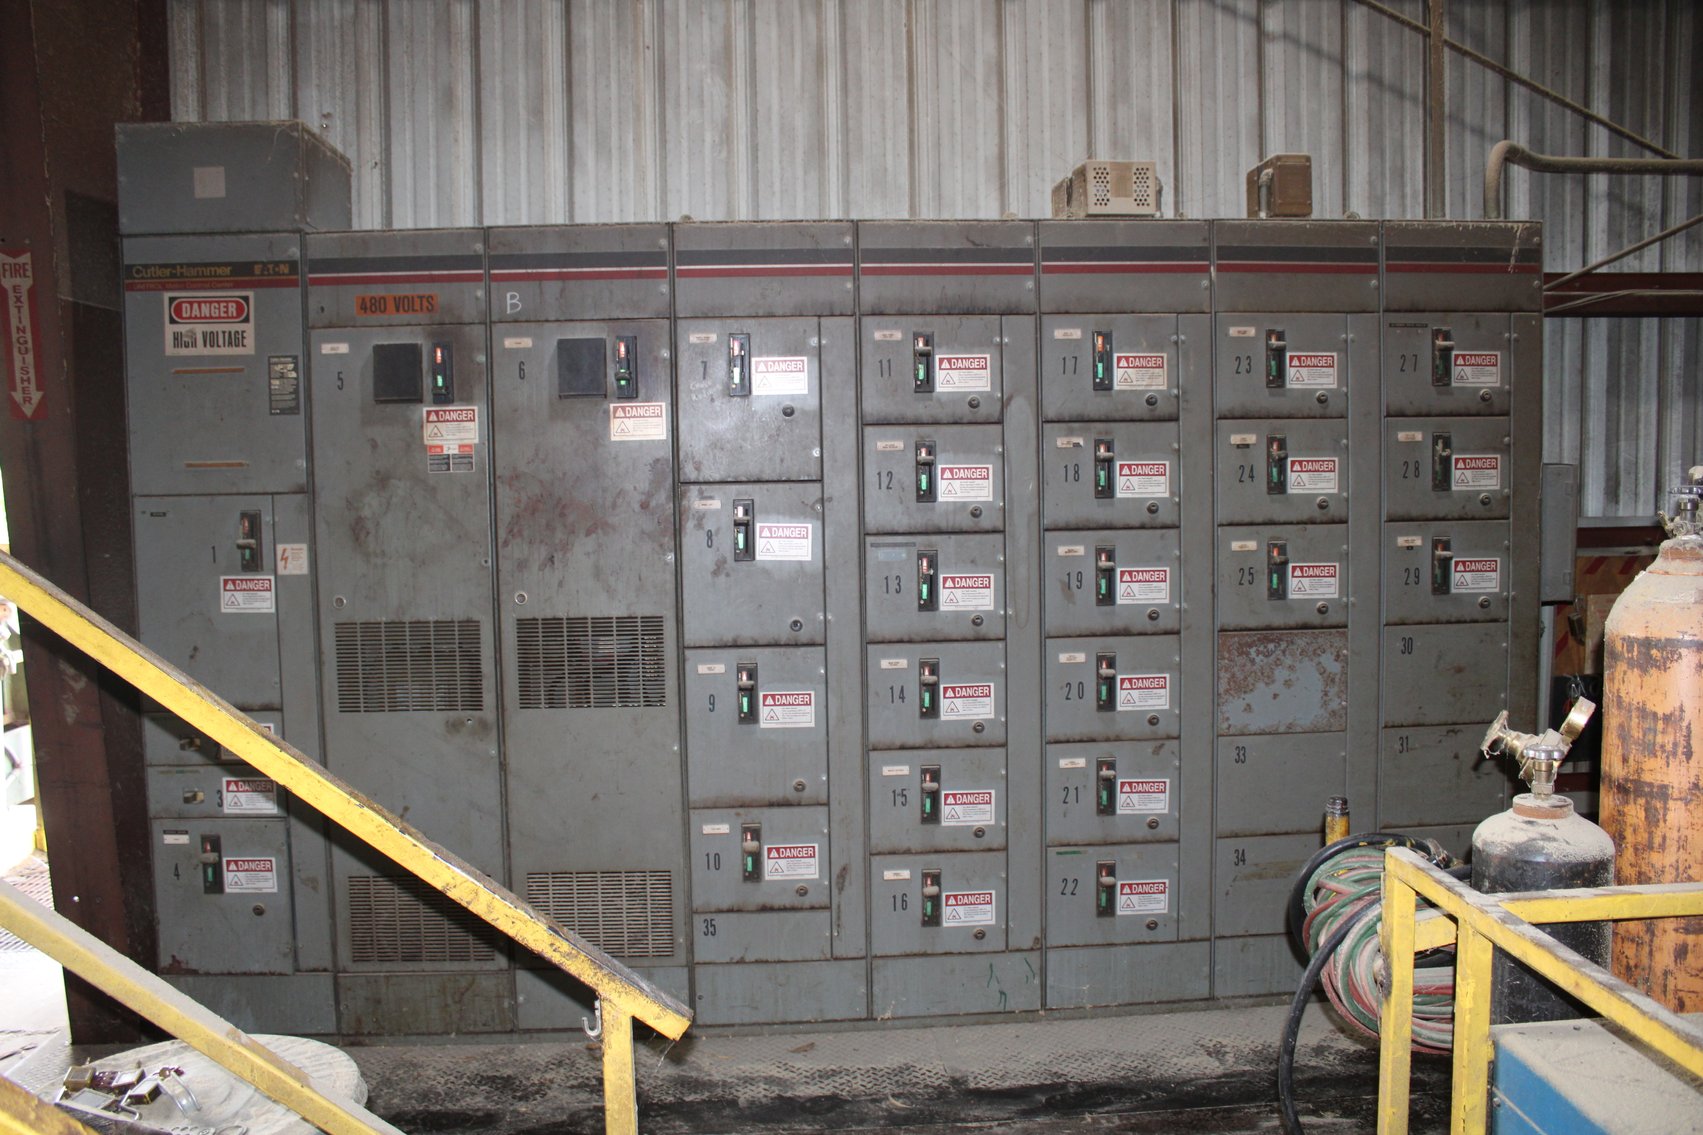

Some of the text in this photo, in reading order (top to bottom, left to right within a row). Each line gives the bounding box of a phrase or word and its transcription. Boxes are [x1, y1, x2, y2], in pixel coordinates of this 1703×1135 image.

[2, 262, 30, 279] FIRE
[132, 264, 232, 278] Cutler-Hammer
[182, 302, 237, 318] DANGER
[360, 294, 434, 313] 480 VOLTS
[506, 292, 522, 314] B
[12, 284, 33, 405] EXTINGUISHER
[202, 330, 246, 348] VOLTAGE
[767, 361, 803, 373] DANGER
[877, 358, 892, 378] 11
[951, 358, 986, 369] DANGER
[1061, 356, 1078, 375] 17
[1128, 356, 1163, 367] DANGER
[1235, 355, 1252, 375] 23
[1300, 355, 1333, 366] DANGER
[1400, 354, 1418, 372] 27
[1465, 355, 1496, 366] DANGER
[518, 361, 526, 380] 6
[700, 360, 707, 380] 7
[336, 371, 344, 391] 5
[439, 410, 474, 422] DANGER
[625, 406, 662, 418] DANGER
[1063, 464, 1080, 482] 18
[1131, 465, 1165, 476] DANGER
[1301, 460, 1334, 471] DANGER
[1402, 460, 1420, 479] 28
[1465, 459, 1497, 469] DANGER
[877, 470, 893, 490] 12
[953, 468, 988, 479] DANGER
[1238, 464, 1255, 483] 24
[706, 528, 713, 548] 8
[771, 526, 808, 538] DANGER
[211, 545, 216, 564] 1
[1302, 566, 1335, 577] DANGER
[1465, 561, 1496, 572] DANGER
[235, 580, 270, 590] DANGER
[884, 575, 902, 594] 13
[954, 577, 990, 588] DANGER
[1066, 571, 1083, 590] 19
[1131, 571, 1166, 582] DANGER
[1238, 567, 1255, 585] 25
[1404, 567, 1420, 586] 29
[1401, 637, 1413, 655] 30
[955, 686, 990, 697] DANGER
[1065, 682, 1084, 701] 20
[1131, 677, 1166, 688] DANGER
[708, 693, 715, 713] 9
[775, 694, 811, 706] DANGER
[889, 685, 906, 704] 14
[1398, 736, 1409, 754] 31
[1234, 746, 1246, 764] 33
[238, 781, 272, 791] DANGER
[1131, 782, 1165, 793] DANGER
[216, 790, 223, 808] 3
[892, 789, 908, 807] 15
[956, 793, 990, 804] DANGER
[1063, 786, 1079, 805] 21
[705, 852, 721, 871] 10
[779, 847, 815, 858] DANGER
[1234, 848, 1246, 866] 34
[173, 863, 180, 881] 4
[238, 861, 272, 871] DANGER
[1060, 878, 1077, 896] 22
[1131, 882, 1165, 893] DANGER
[892, 893, 908, 912] 16
[957, 893, 991, 904] DANGER
[703, 918, 717, 937] 35
